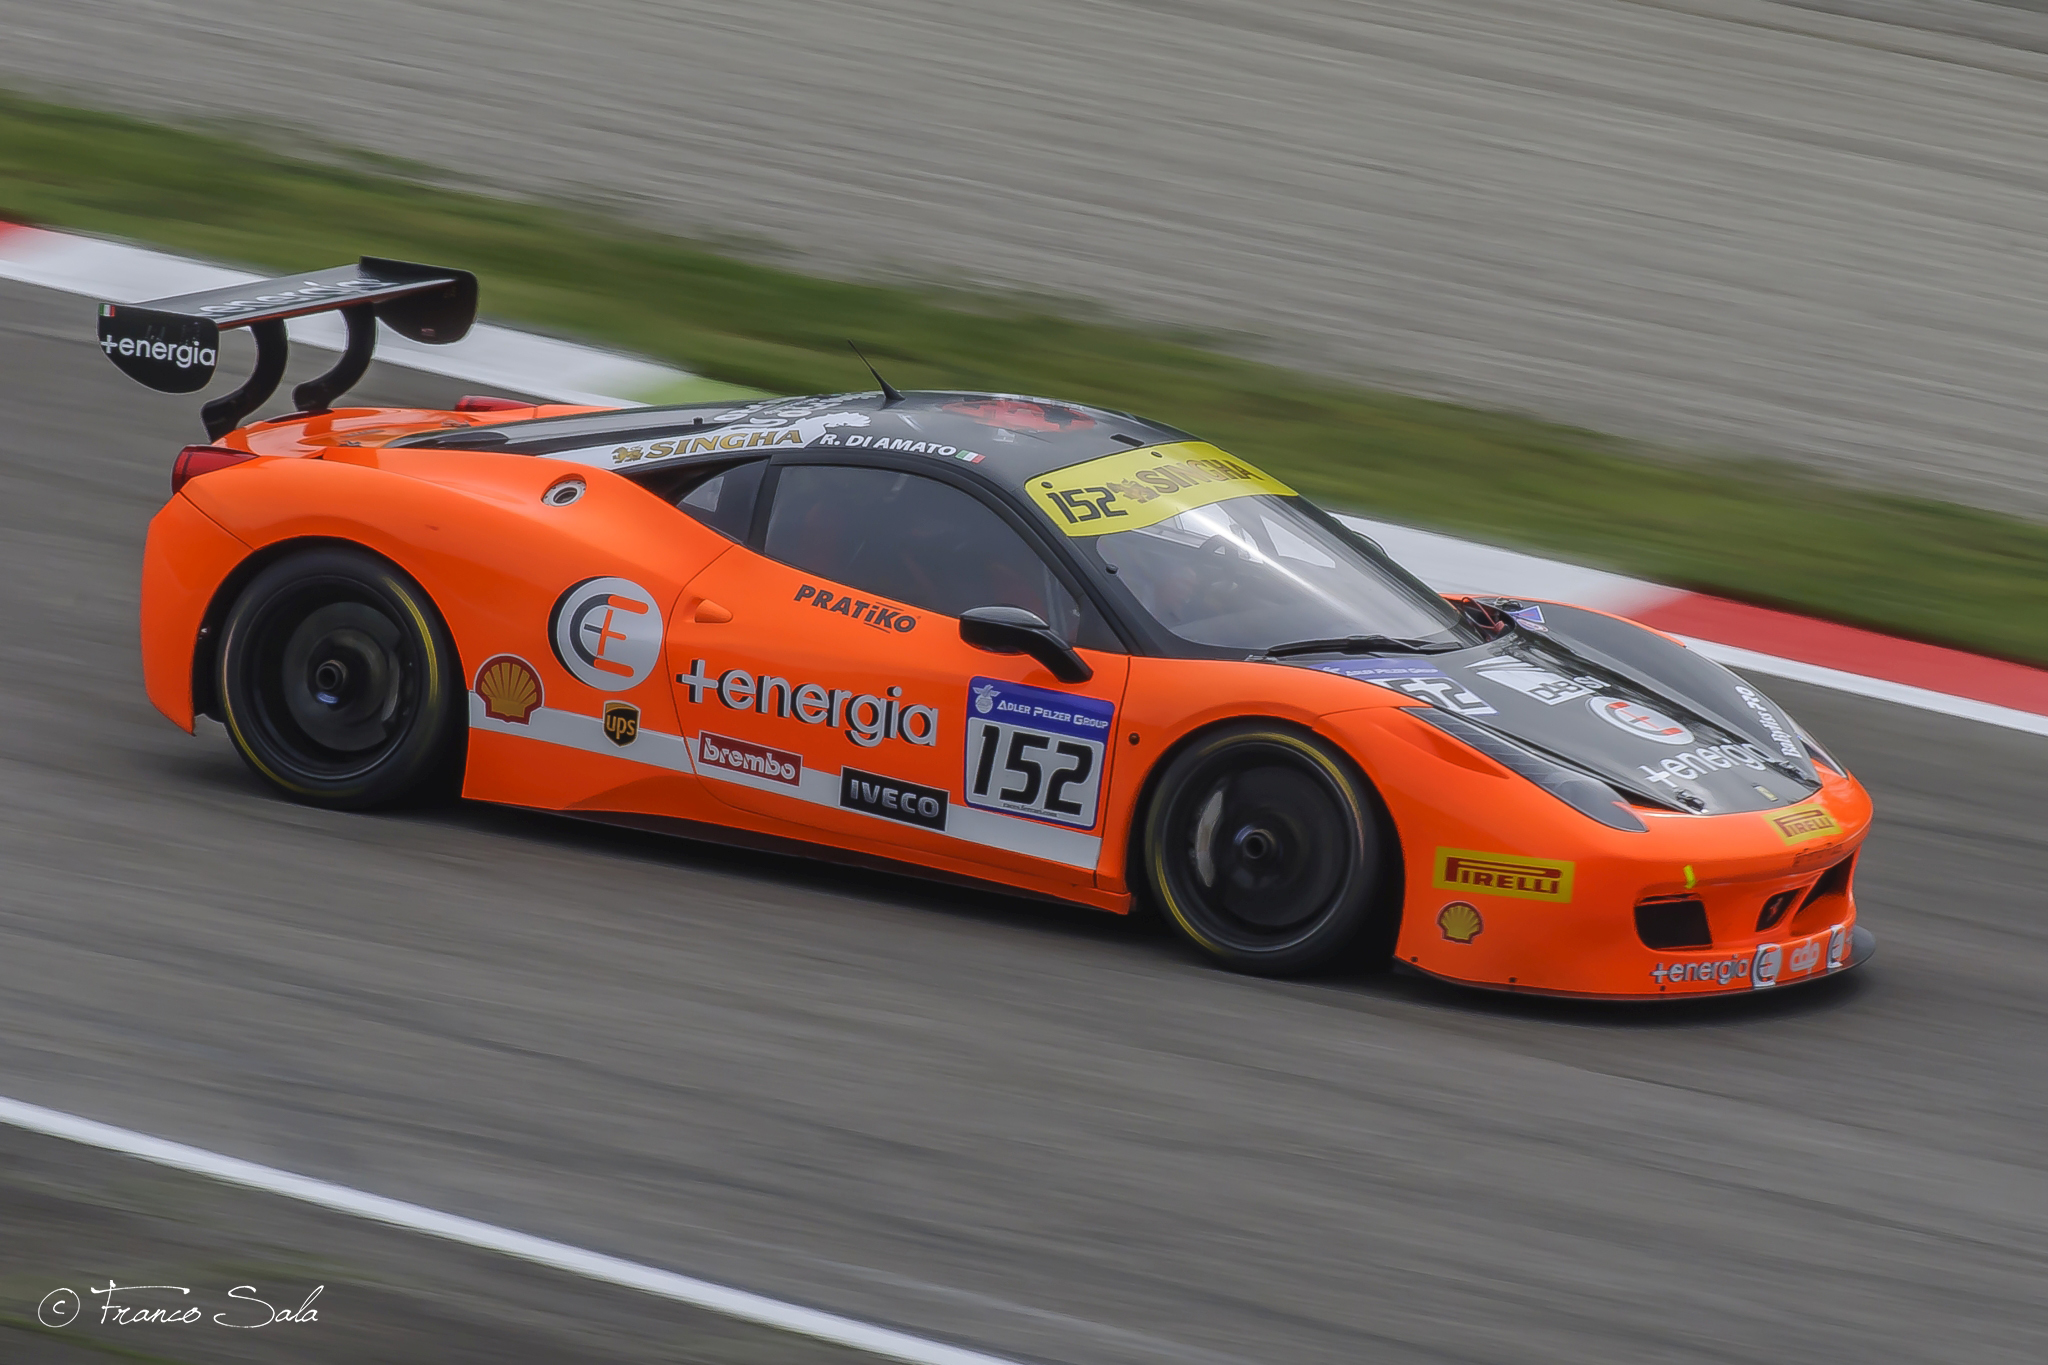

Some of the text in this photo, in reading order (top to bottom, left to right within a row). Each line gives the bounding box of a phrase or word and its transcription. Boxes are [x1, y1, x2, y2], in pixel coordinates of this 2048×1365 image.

[100, 334, 216, 368] +energia
[643, 429, 803, 460] SINGHA
[819, 432, 957, 458] R. DI AMATO
[1135, 458, 1266, 496] SINGHA
[1048, 487, 1129, 525] 152
[675, 658, 939, 748] +energia
[996, 699, 1109, 729] ADLER PELZER GROUP
[605, 714, 637, 741] ups
[703, 738, 796, 781] brembo
[972, 723, 1094, 817] 152
[849, 779, 940, 819] IVECO
[1772, 809, 1835, 838] PIRELLI
[1444, 856, 1563, 895] PIRELLI
